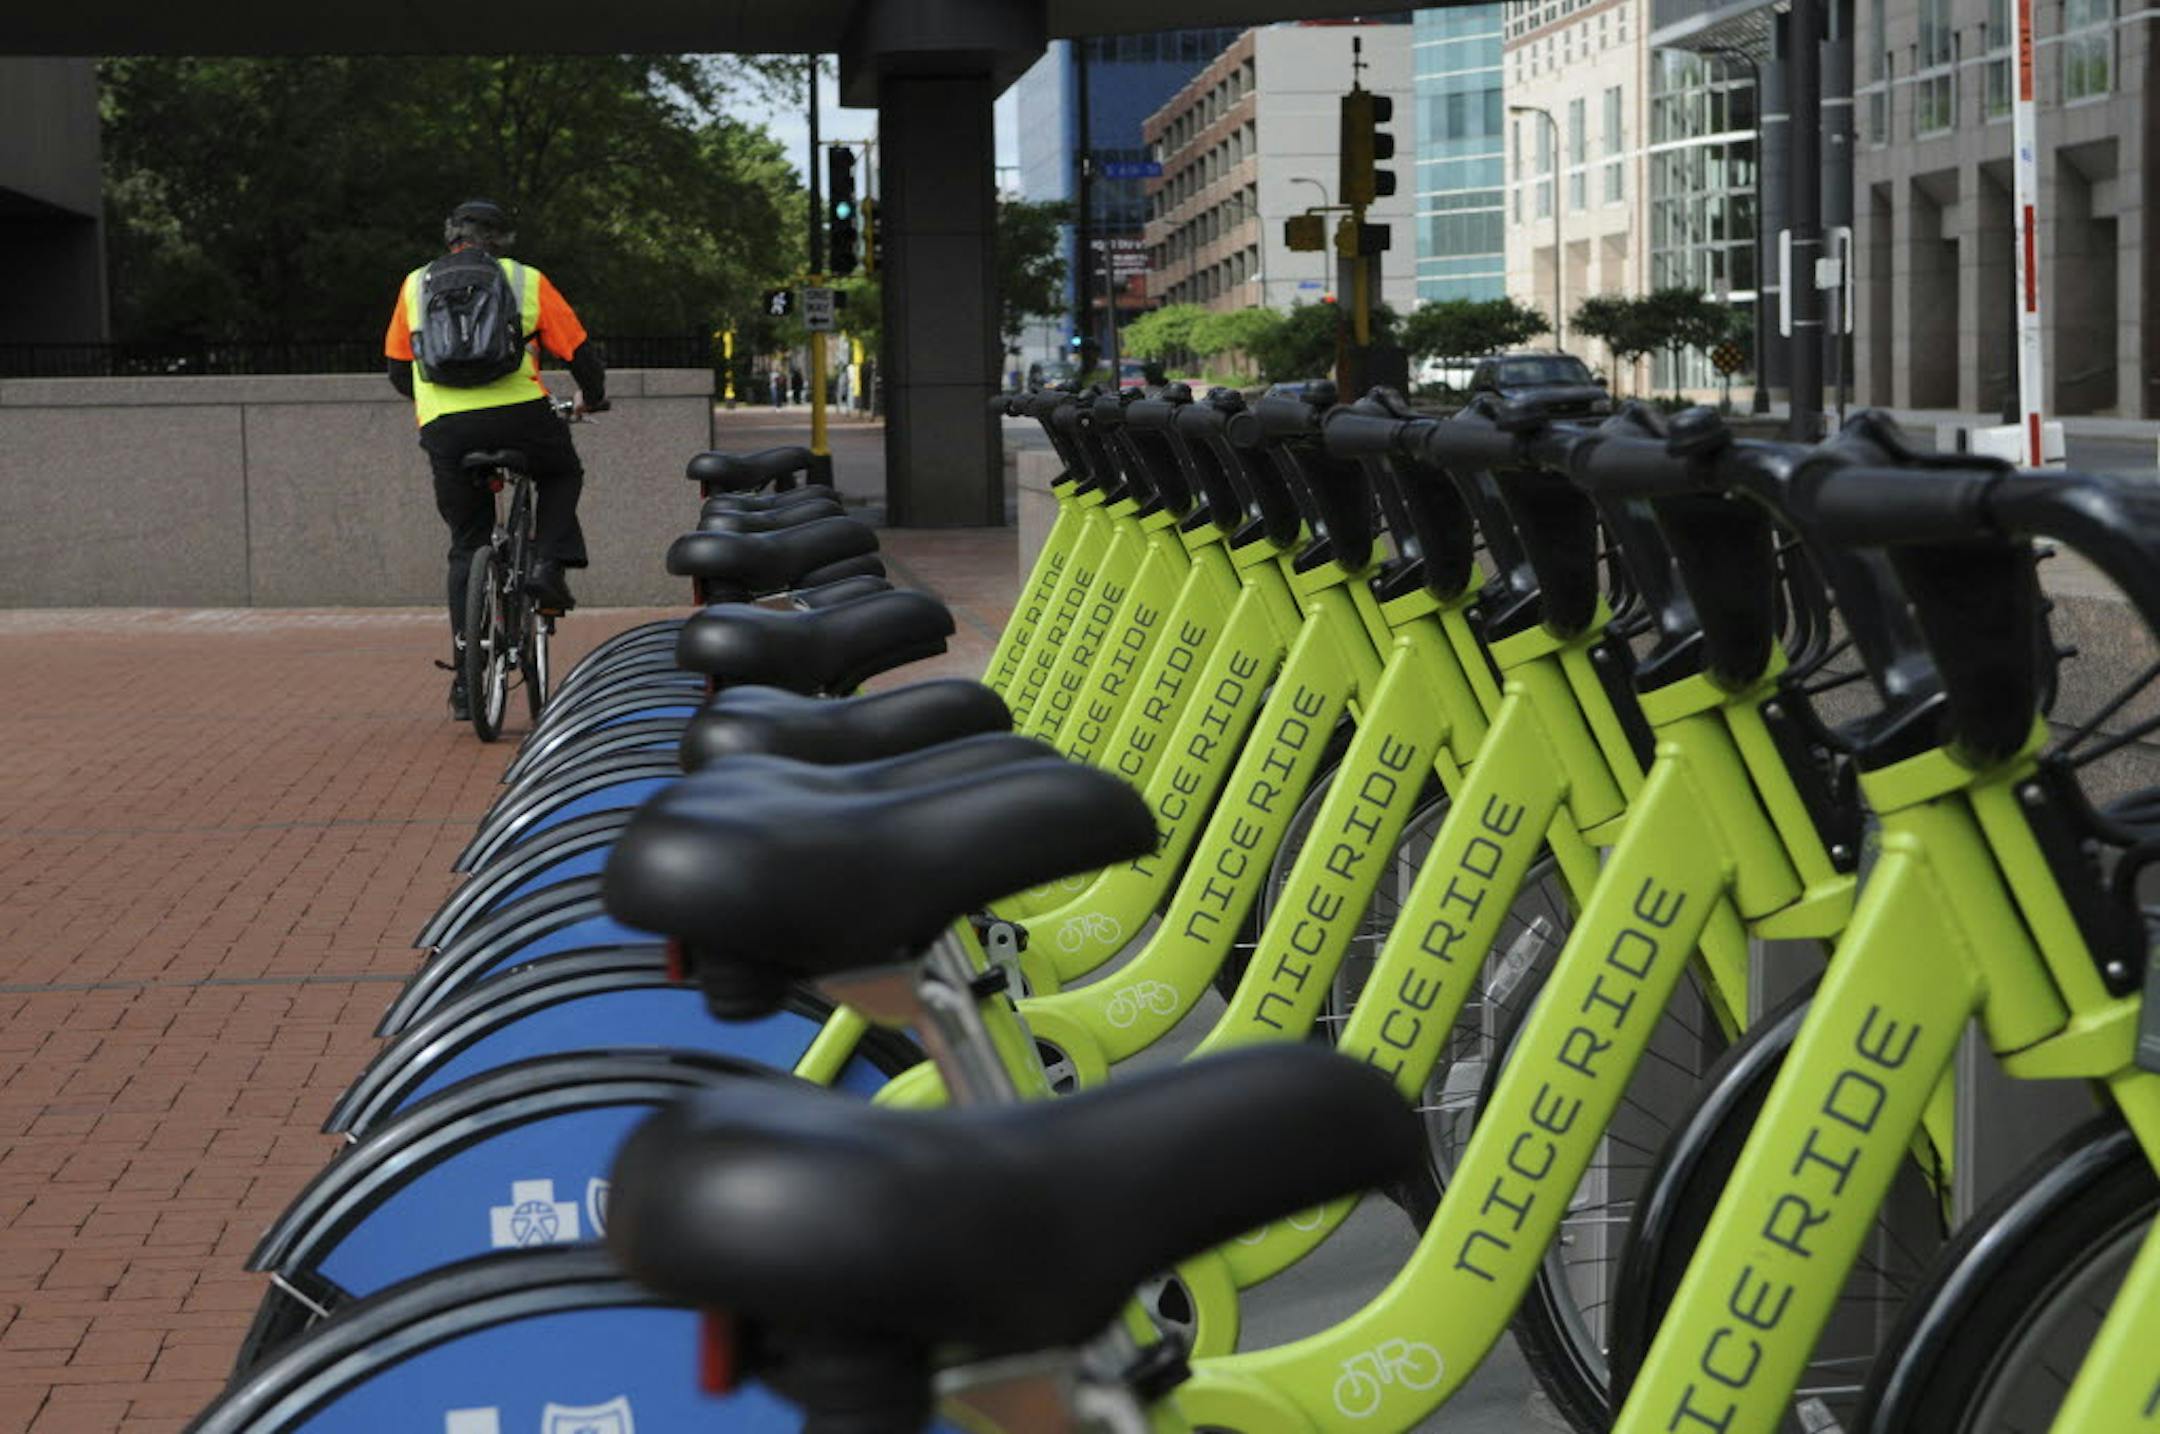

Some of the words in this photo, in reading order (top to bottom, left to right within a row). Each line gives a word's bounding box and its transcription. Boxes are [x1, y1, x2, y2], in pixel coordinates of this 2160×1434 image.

[1012, 649, 1057, 727] NICE
[1047, 568, 1095, 646] RIDE
[1025, 552, 1064, 624] RIDE
[1072, 581, 1125, 667] RIDE
[1067, 699, 1112, 765] ICE
[1101, 604, 1158, 696] RIDE
[1118, 725, 1157, 776] CE
[1144, 620, 1207, 723] RIDE
[1187, 650, 1259, 763] RIDE
[1184, 817, 1264, 944] NICE
[1247, 685, 1325, 814] RIDE
[1253, 885, 1344, 1030] NICE
[1326, 734, 1416, 881] RIDE
[1366, 968, 1442, 1083] ICE
[1420, 794, 1525, 963] RIDE
[1454, 1083, 1582, 1283] NICE
[1557, 877, 1686, 1079] RIDE
[1668, 1265, 1794, 1434] ICE
[1762, 1006, 1921, 1259] RIDE
